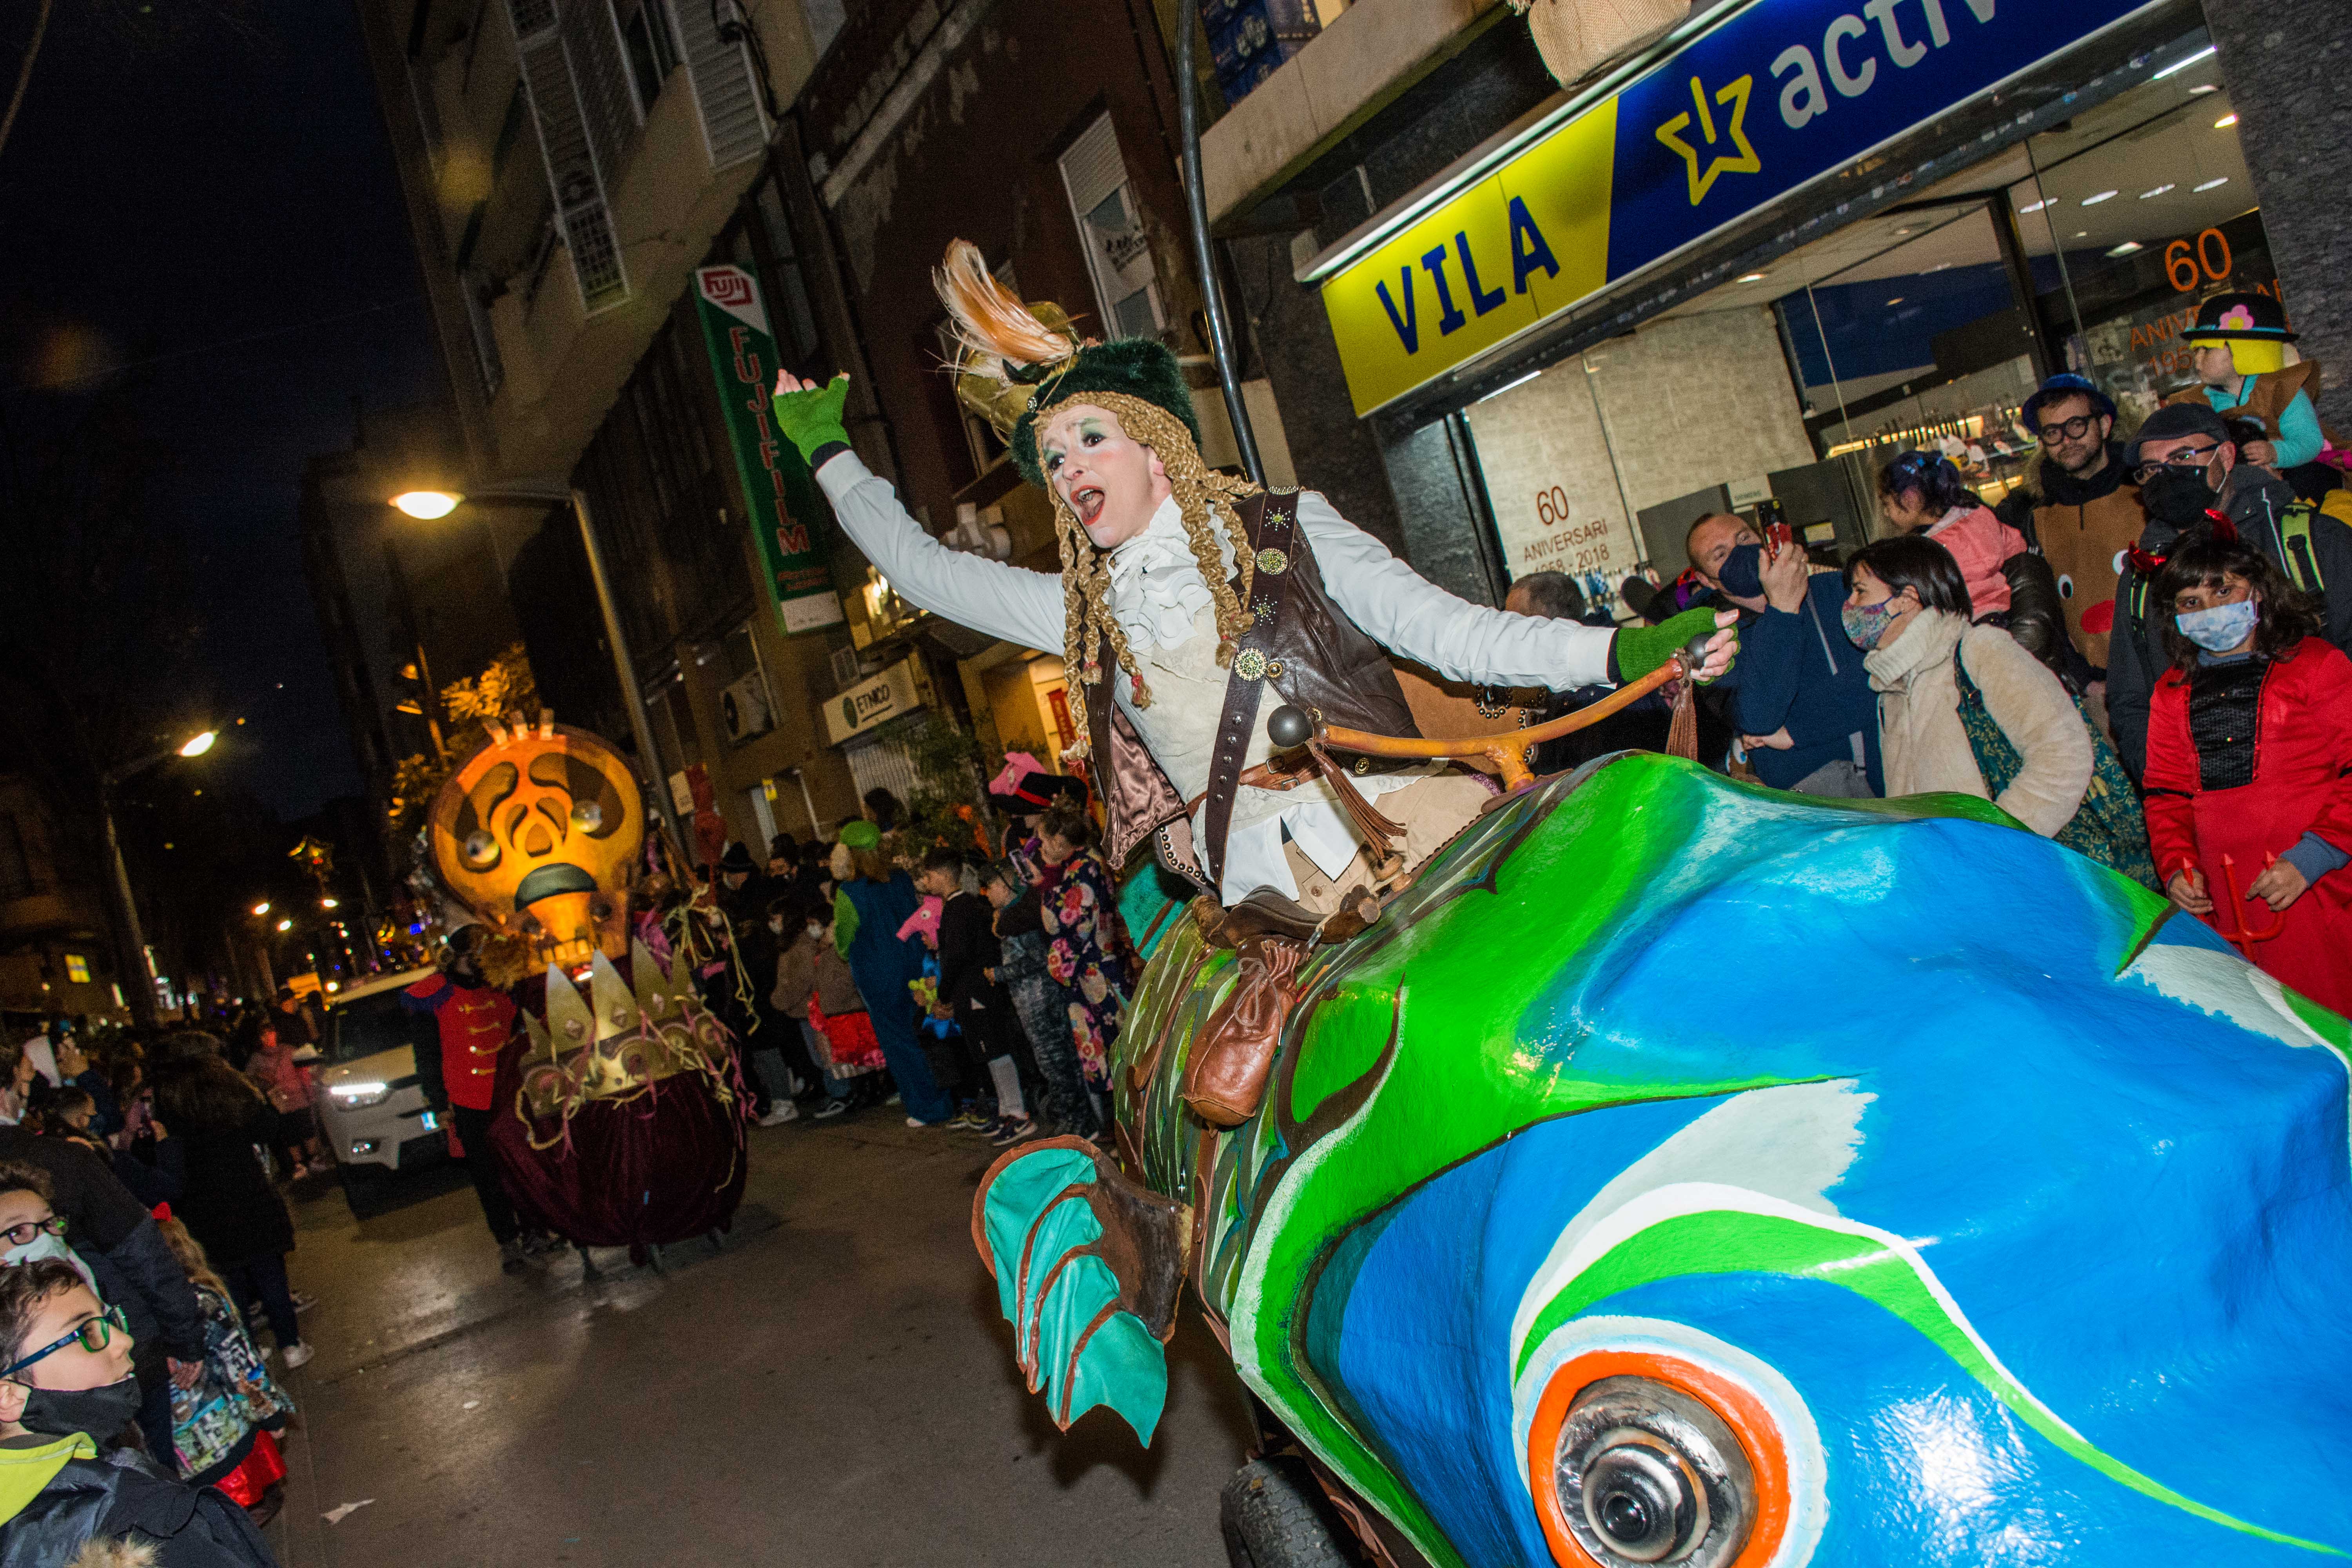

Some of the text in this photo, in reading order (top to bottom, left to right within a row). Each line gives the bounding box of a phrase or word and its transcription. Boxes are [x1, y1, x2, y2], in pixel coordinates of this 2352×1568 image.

[1769, 0, 1995, 130] acti
[1375, 196, 1560, 356] VILA
[2165, 228, 2232, 292] 60
[729, 325, 811, 556] FUJIFILM
[1537, 485, 1569, 526] 60
[1524, 518, 1608, 563] ANIVERSARI
[1576, 543, 1610, 569] 2018
